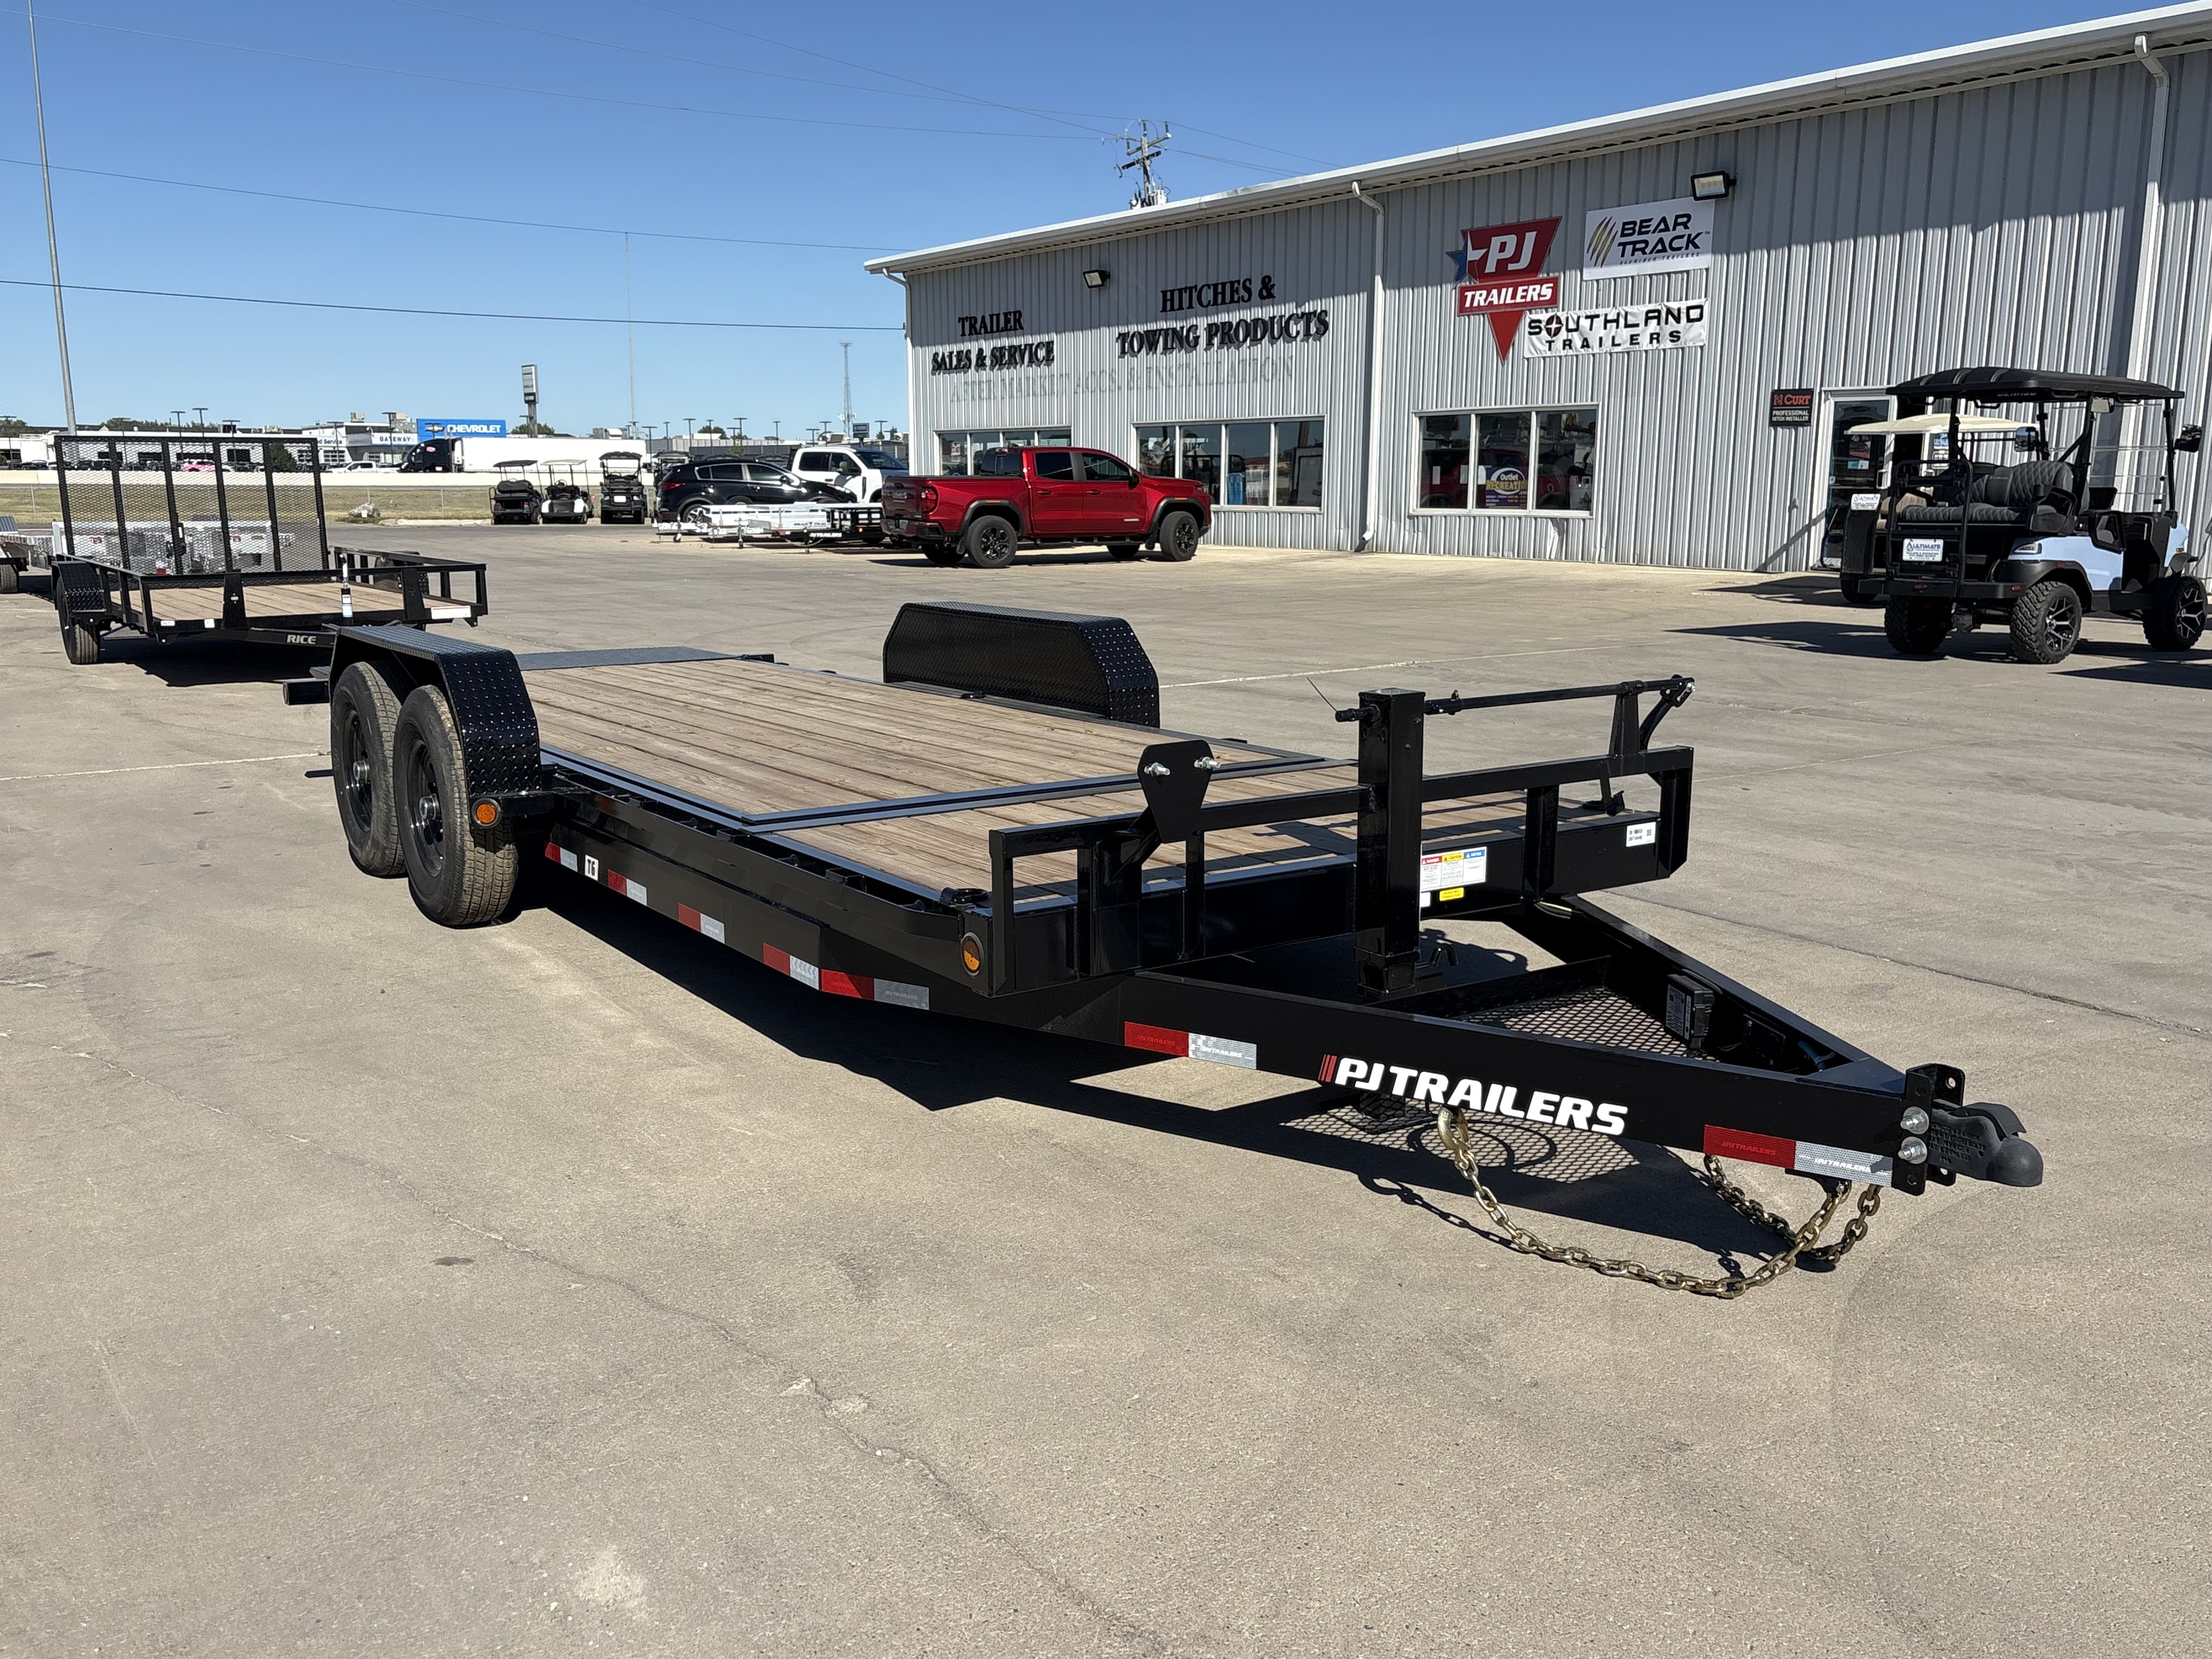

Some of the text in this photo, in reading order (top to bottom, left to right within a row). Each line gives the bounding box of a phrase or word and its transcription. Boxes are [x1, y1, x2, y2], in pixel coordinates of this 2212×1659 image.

[1620, 213, 1691, 238] BEAR
[1485, 231, 1537, 273] PJ
[1617, 232, 1704, 258] TRACK
[1160, 275, 1276, 313] HITCHES &
[1464, 283, 1553, 307] TRAILERS
[958, 310, 1024, 336] TRAILER
[1116, 310, 1329, 355] TOWING PRODUCTS
[1527, 304, 1704, 337] SOUTHLAND
[1545, 331, 1681, 351] TRAILERS
[932, 340, 1054, 371] SALES & SERVICE
[1785, 394, 1811, 405] CURT
[447, 425, 501, 433] CHEVROLET
[286, 634, 317, 645] RICE
[587, 859, 595, 876] T6
[1335, 1057, 1628, 1136] PJ TRAILERS
[1734, 1143, 1776, 1156] TRAILERS
[1827, 1160, 1871, 1173] TRAILERS
